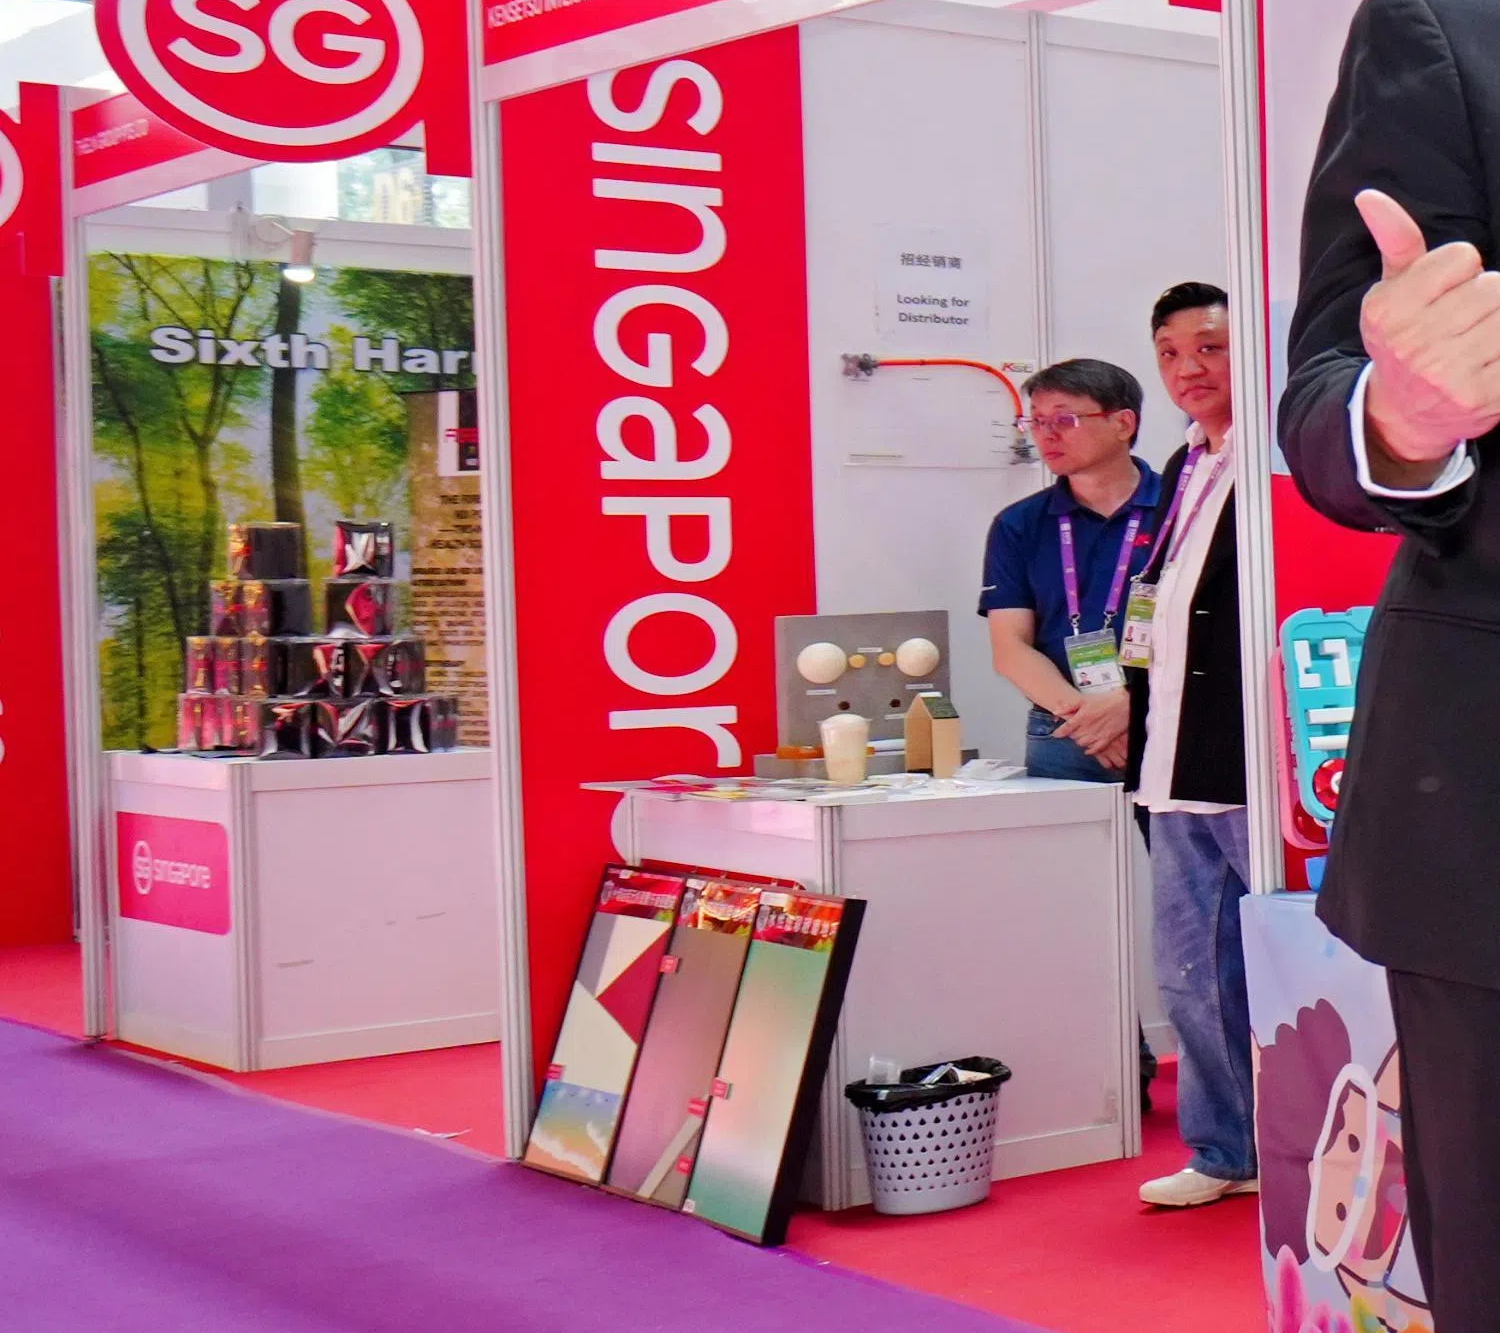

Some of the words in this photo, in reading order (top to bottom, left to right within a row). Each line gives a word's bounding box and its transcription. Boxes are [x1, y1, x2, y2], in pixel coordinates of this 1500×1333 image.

[900, 252, 963, 269] 招经销商
[896, 294, 948, 308] Looking
[951, 294, 970, 308] for
[898, 312, 969, 326] Distributor
[149, 324, 330, 370] Sixth
[353, 335, 476, 376] Har
